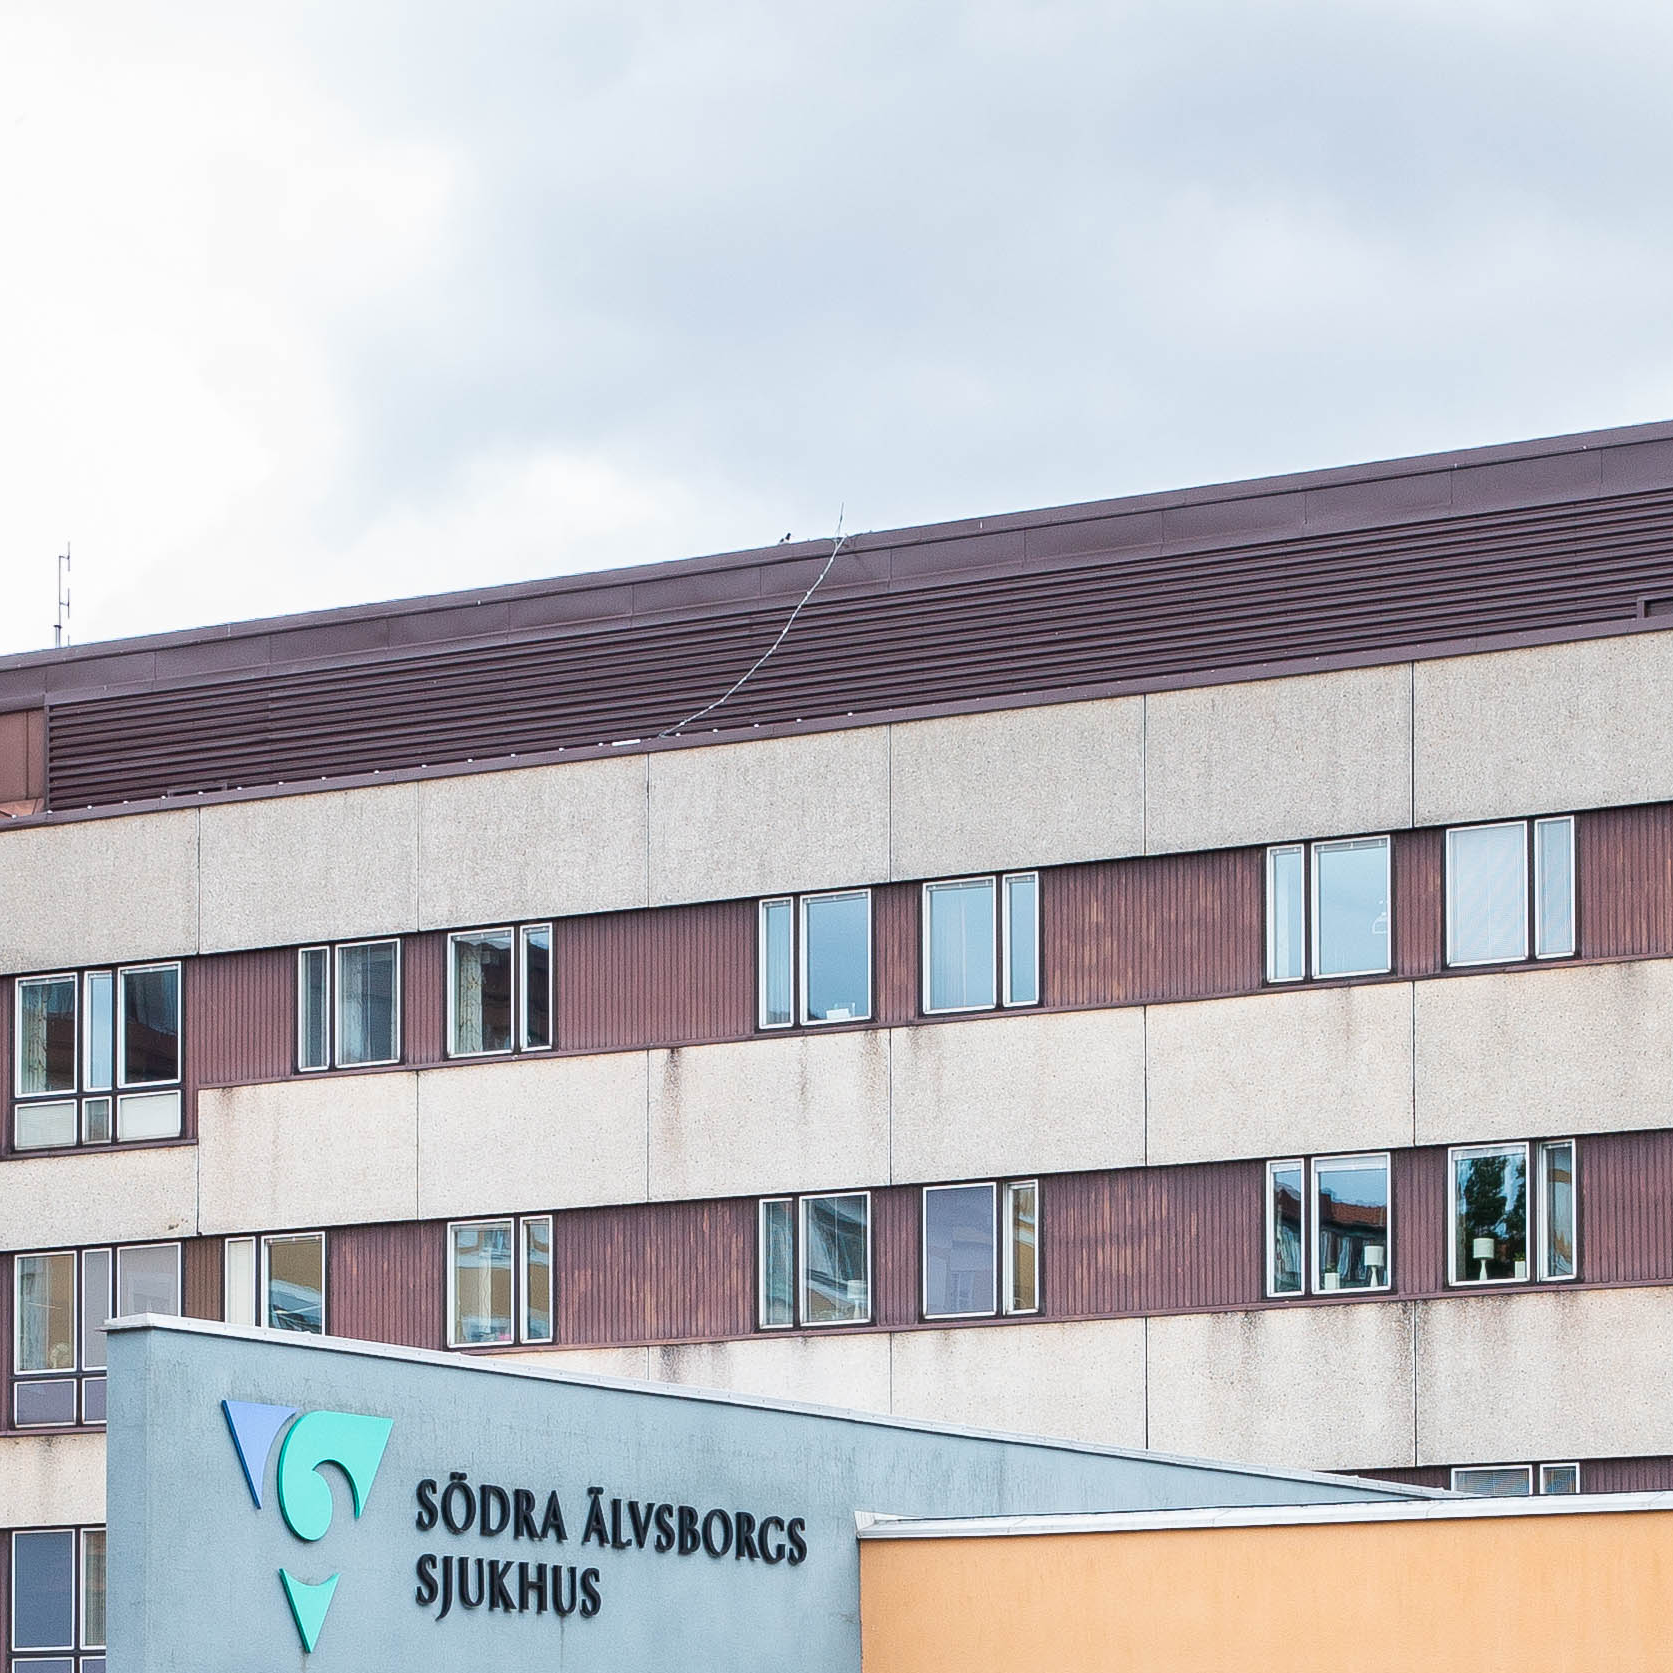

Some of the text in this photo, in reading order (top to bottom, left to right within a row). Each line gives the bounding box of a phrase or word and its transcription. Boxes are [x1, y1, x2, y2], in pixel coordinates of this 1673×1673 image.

[415, 1471, 808, 1568] SÖDRA ÄLVSBORGS
[415, 1553, 602, 1622] SJUKHUS
